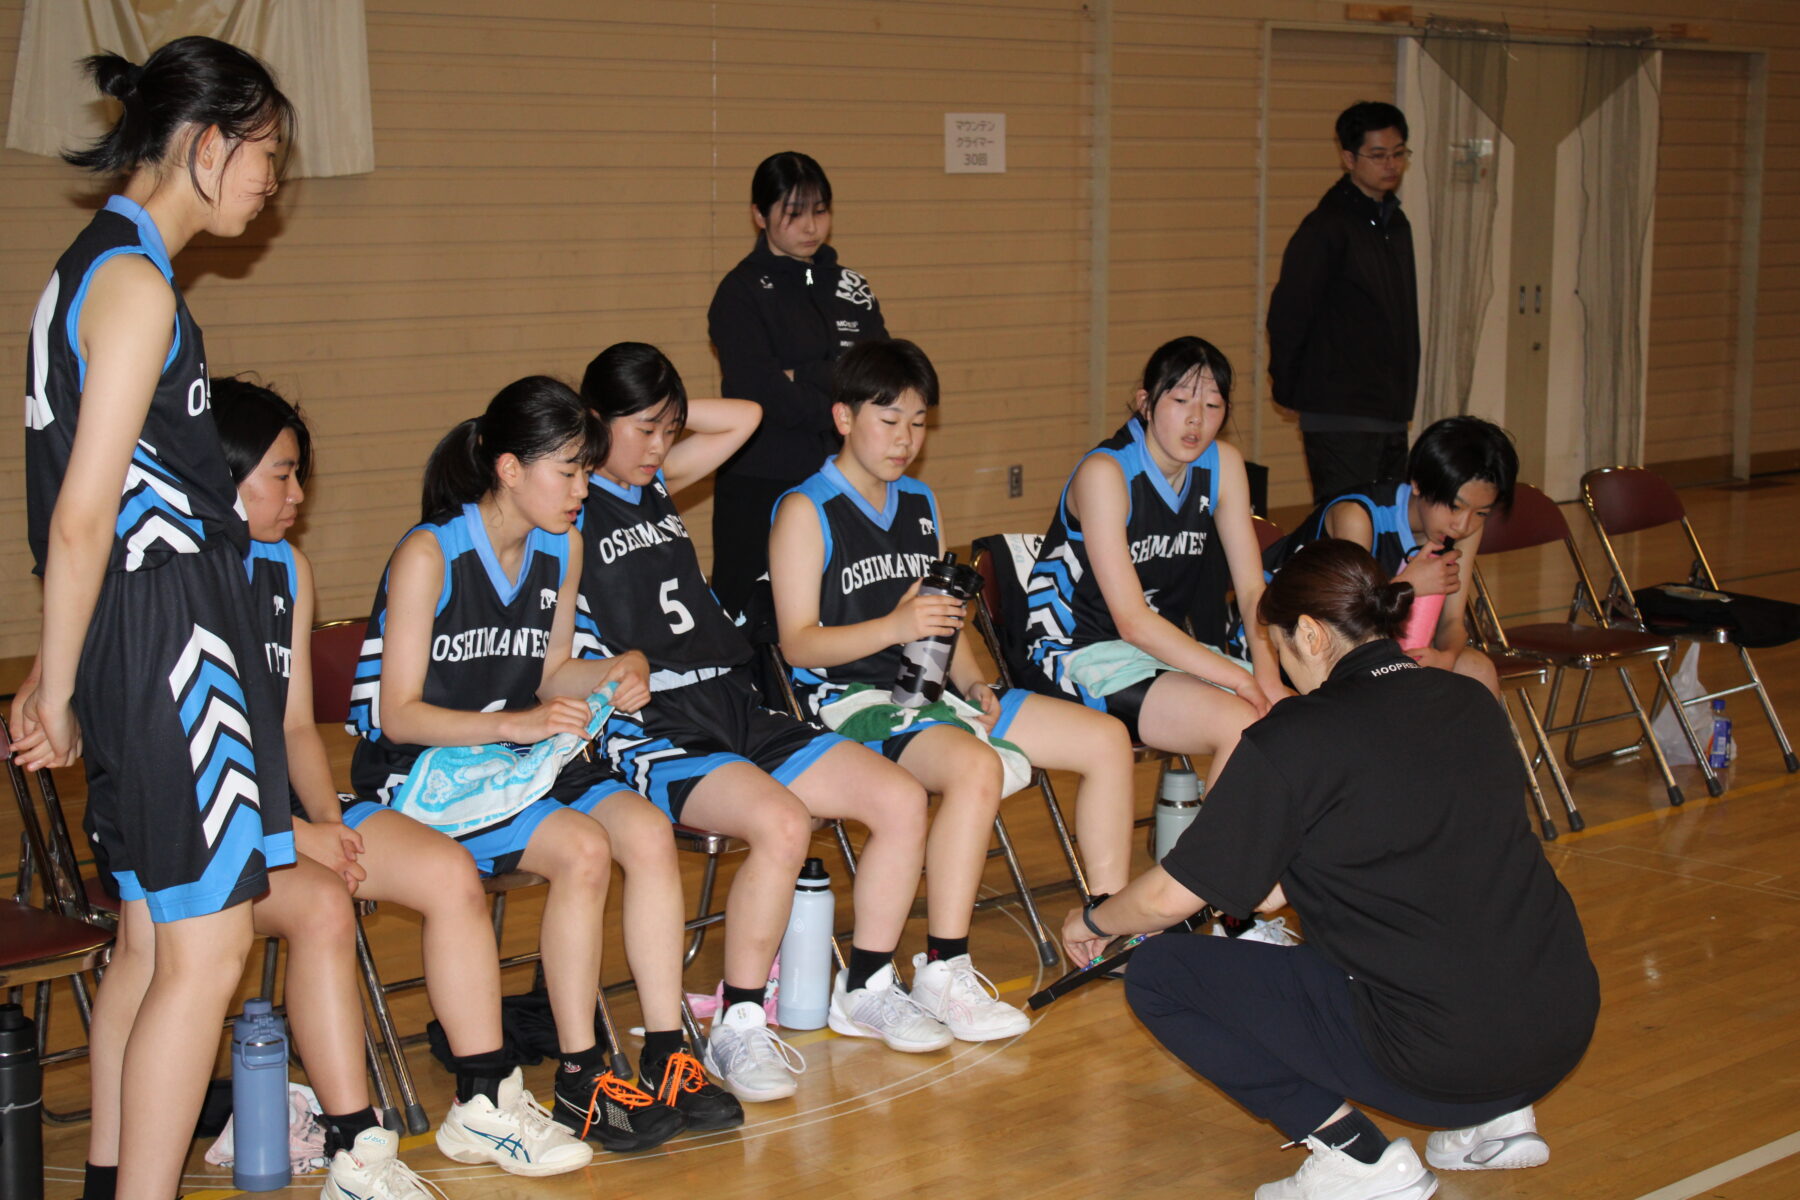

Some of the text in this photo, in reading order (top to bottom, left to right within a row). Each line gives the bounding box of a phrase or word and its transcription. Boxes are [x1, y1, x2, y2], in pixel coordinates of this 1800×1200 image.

[955, 120, 996, 132] マウンテン
[956, 136, 995, 148] クライマー
[963, 152, 988, 167] 30回
[841, 552, 937, 595] OSHIMAWE
[659, 577, 695, 635] 5
